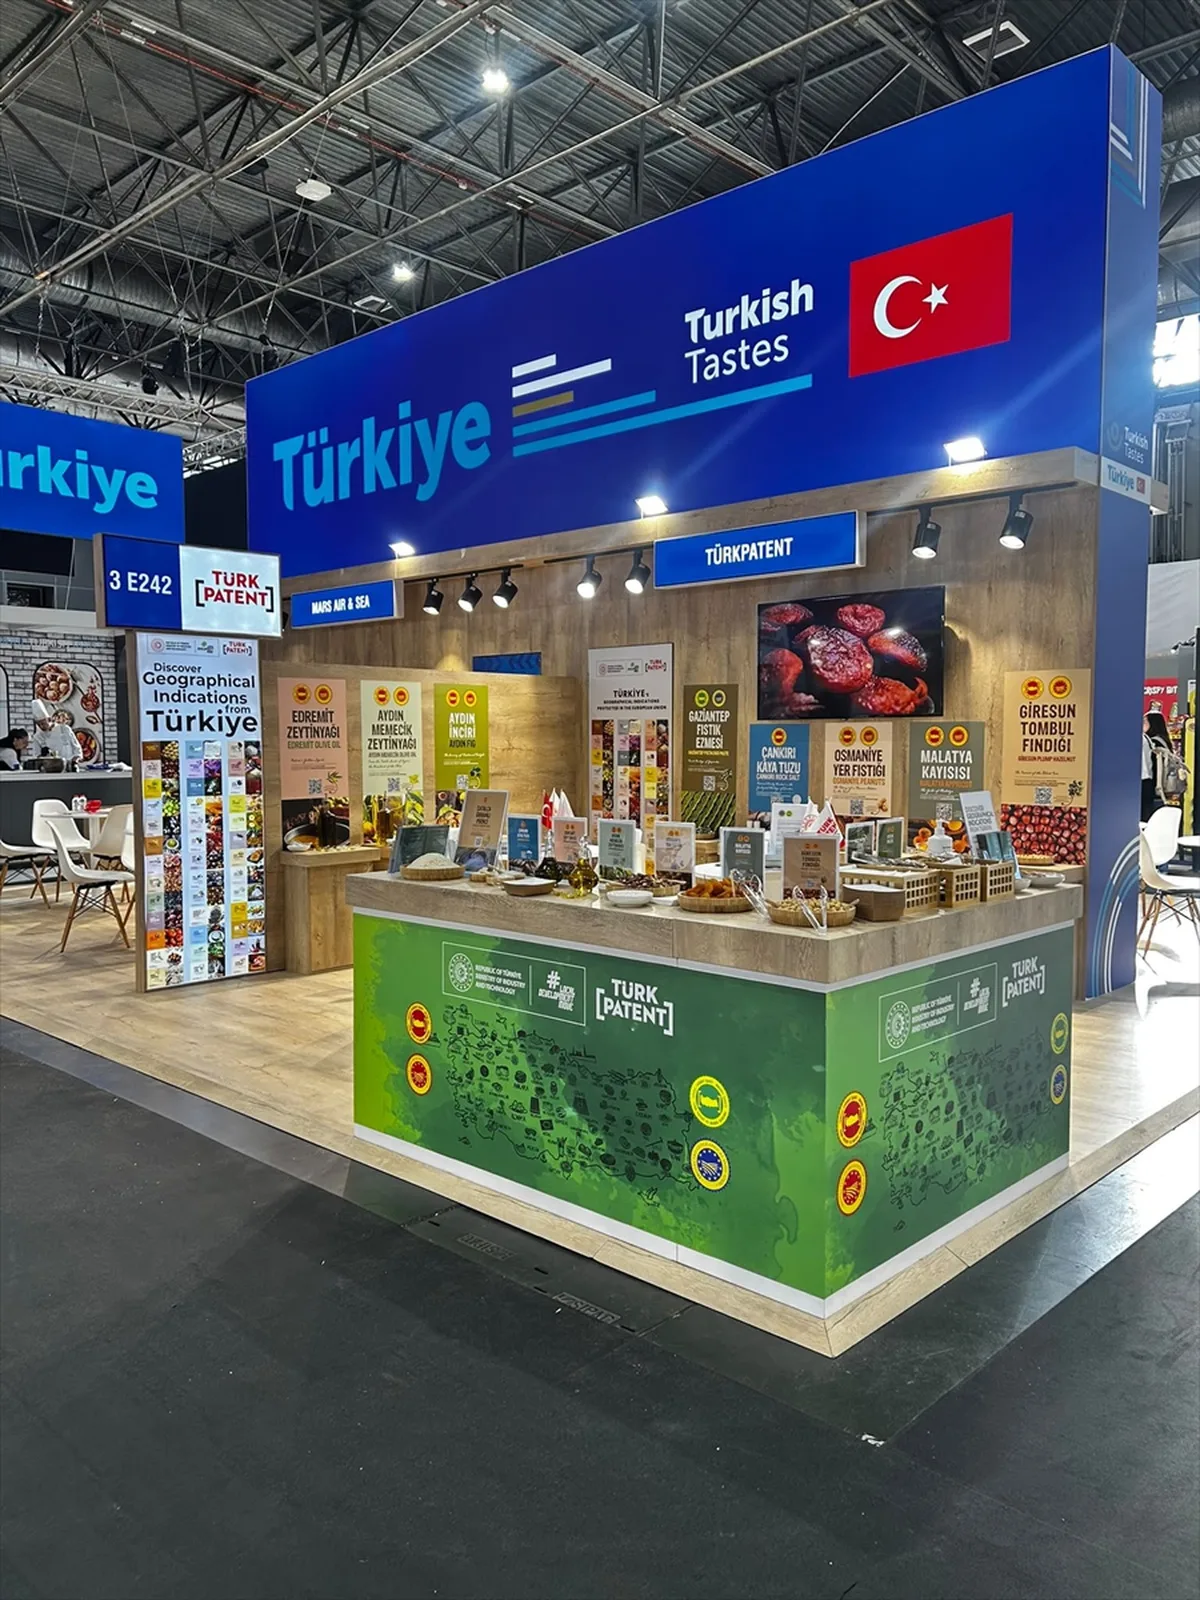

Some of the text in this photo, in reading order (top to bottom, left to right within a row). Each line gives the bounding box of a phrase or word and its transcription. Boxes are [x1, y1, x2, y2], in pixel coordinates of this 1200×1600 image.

[684, 278, 814, 344] Turkish
[684, 333, 789, 384] Tastes
[273, 400, 491, 511] Türkiye
[705, 537, 793, 566] TÜRKPATENT
[109, 570, 173, 595] 3 E242
[211, 570, 260, 589] TÜRK
[204, 587, 268, 606] PATENT
[311, 595, 370, 615] MARS AIR & SEA
[154, 662, 202, 673] Discover
[143, 671, 255, 689] Geographical
[154, 689, 248, 705] Indications
[225, 704, 251, 714] from
[292, 708, 334, 723] EDREMİT
[377, 710, 404, 721] AYDIN
[688, 708, 730, 722] GAZİANTEP
[1019, 702, 1076, 718] GİRESUN
[146, 709, 258, 737] Türkiye
[449, 712, 475, 725] AYDIN
[286, 723, 340, 738] ZEYTİNYAĞI
[371, 721, 412, 735] MEMECİK
[697, 724, 721, 735] FISTIK
[1020, 721, 1074, 735] TOMBUL
[368, 736, 416, 750] ZEYTİNYAĞI
[696, 735, 723, 749] EZMESİ
[1022, 736, 1071, 752] FINDIĞI
[761, 746, 796, 760] ÇANKIRI
[834, 746, 883, 761] OSMANİYE
[920, 749, 973, 764] MALATYA
[757, 761, 801, 773] KAYA TUZU
[833, 762, 886, 777] YER FISTIĞI
[921, 765, 971, 779] KAYISISI
[1007, 973, 1042, 999] PATENT
[604, 996, 667, 1026] PATENT
